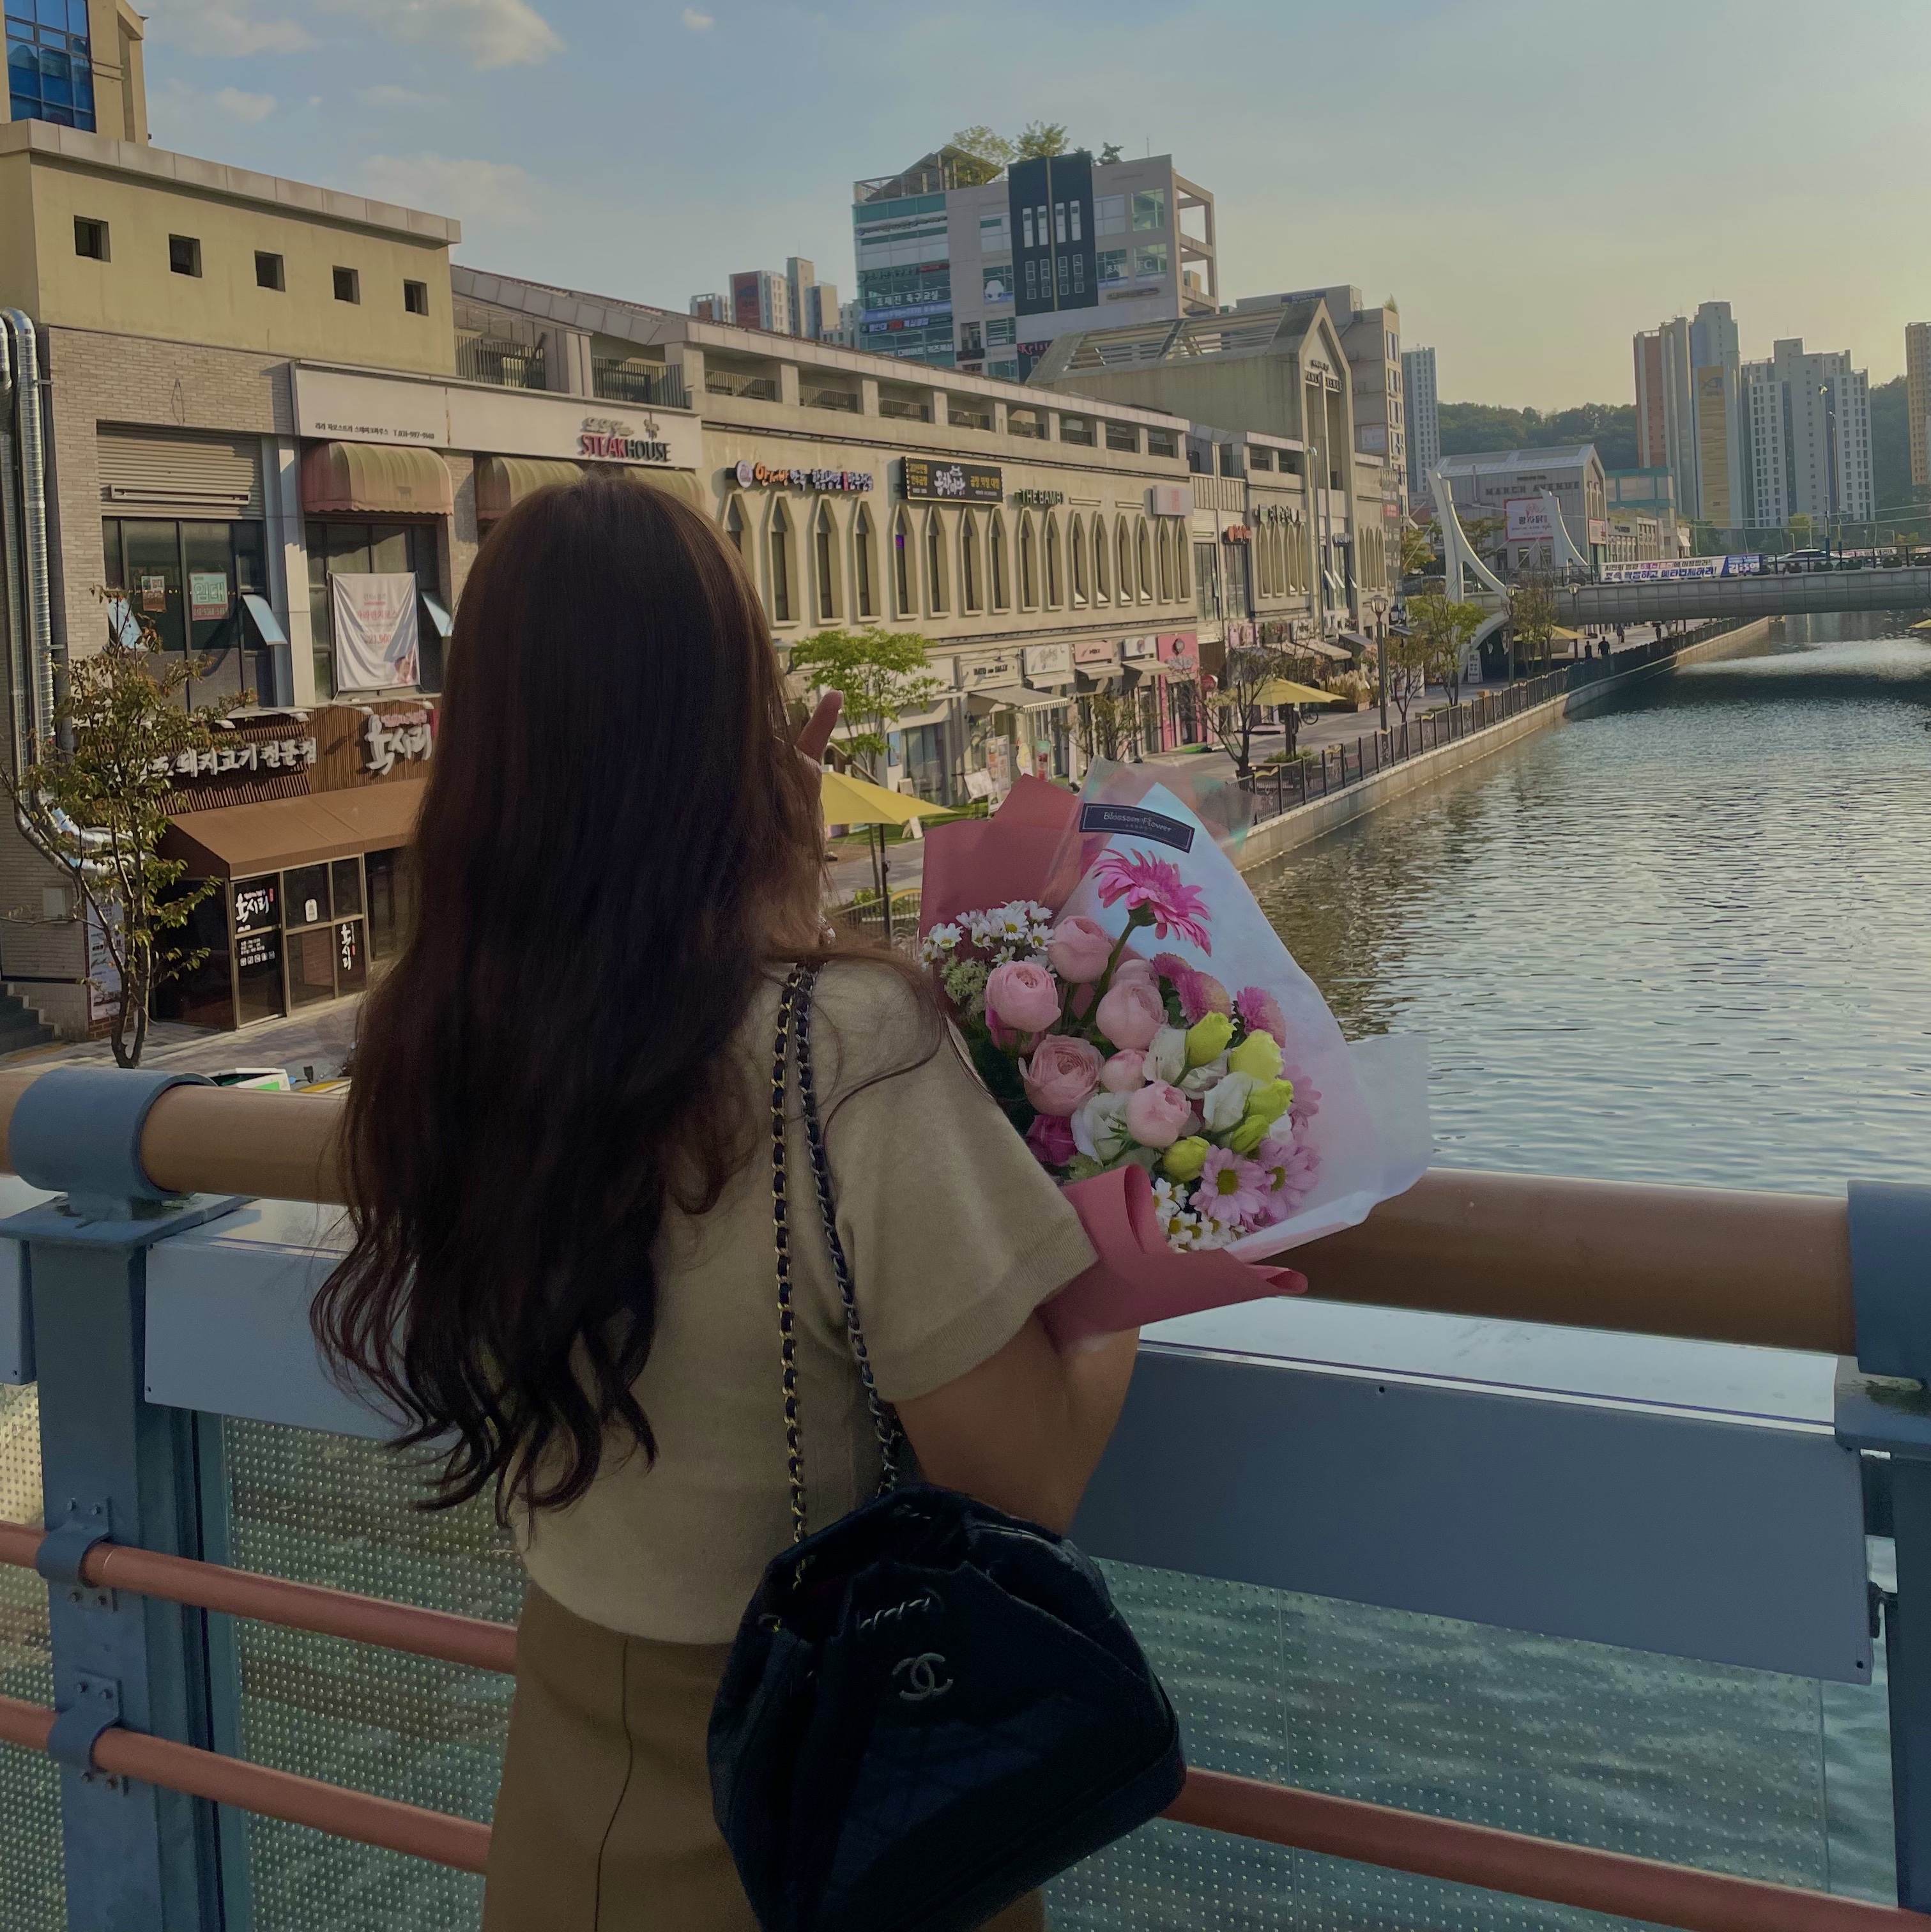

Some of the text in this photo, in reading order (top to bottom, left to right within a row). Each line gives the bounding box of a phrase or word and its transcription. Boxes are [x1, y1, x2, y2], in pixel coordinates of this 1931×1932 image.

[1486, 481, 1580, 495] MARCH AVENUE
[194, 582, 225, 602] 임대
[176, 746, 257, 778] 돼지고기
[260, 737, 317, 768] 전문점
[1142, 817, 1172, 832] Flower
